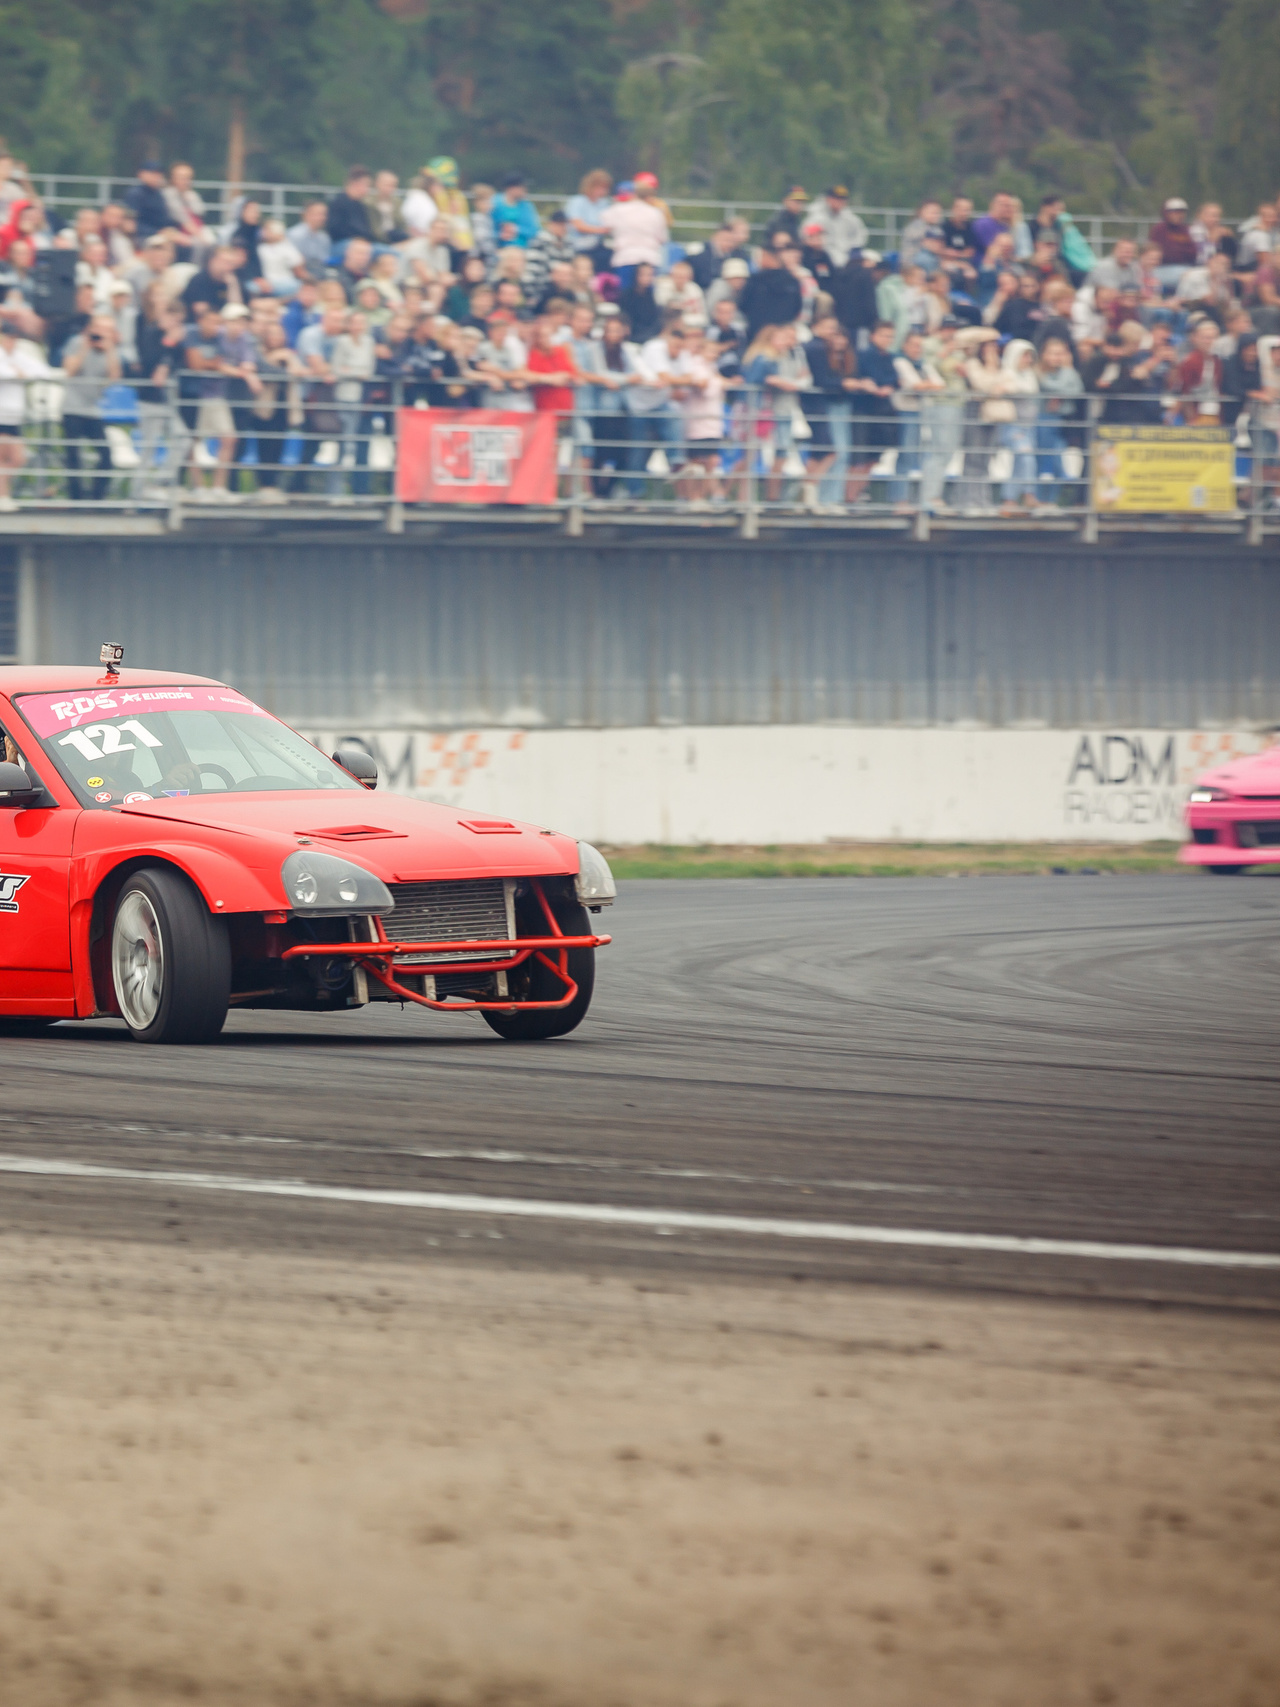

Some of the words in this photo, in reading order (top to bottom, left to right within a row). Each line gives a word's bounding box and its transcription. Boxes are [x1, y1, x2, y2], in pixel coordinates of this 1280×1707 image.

[50, 693, 118, 721] RDS
[142, 692, 194, 700] EUROPE
[58, 719, 163, 761] 121
[1067, 735, 1177, 786] ADM
